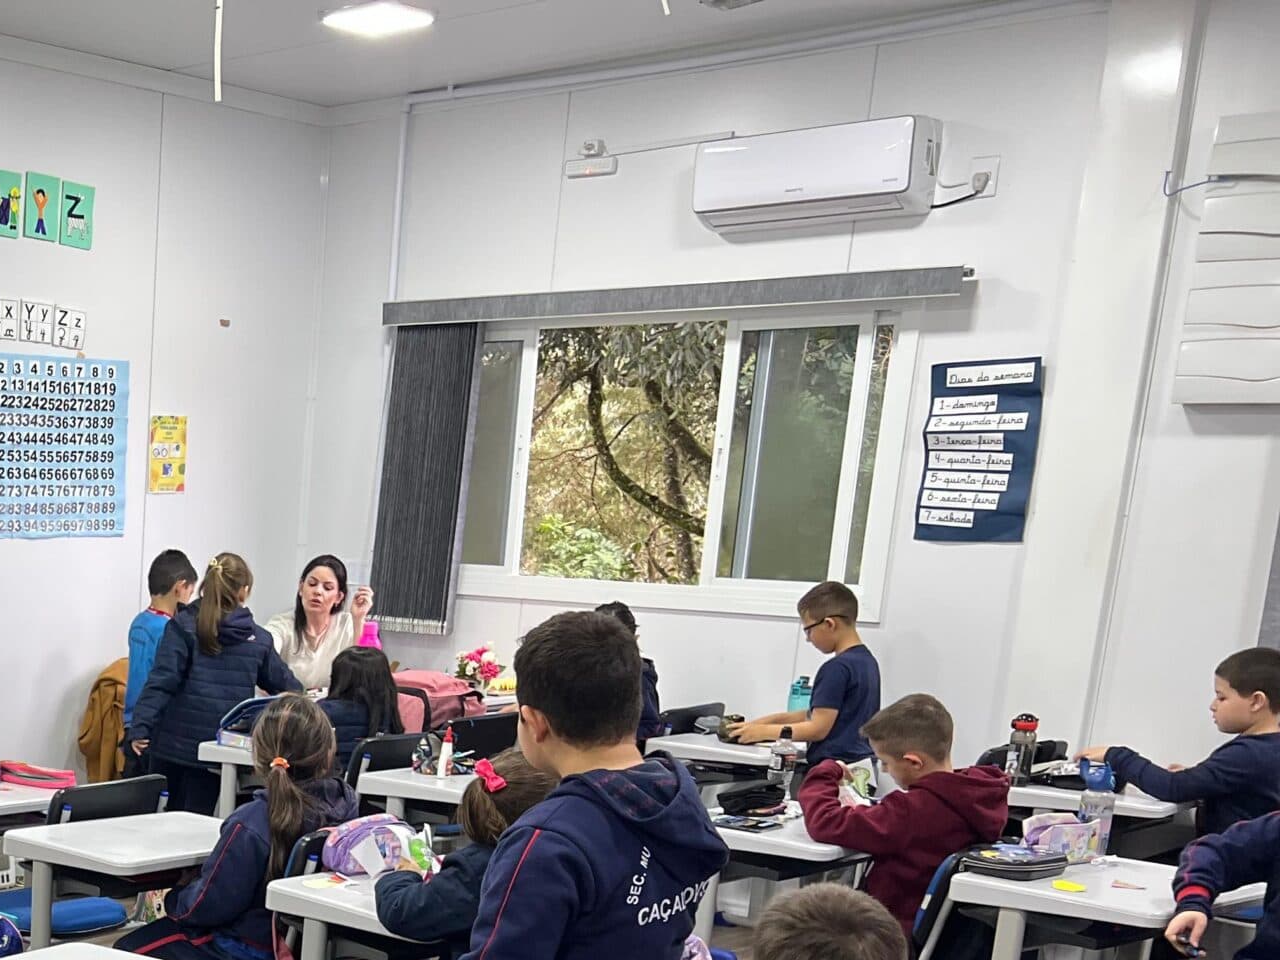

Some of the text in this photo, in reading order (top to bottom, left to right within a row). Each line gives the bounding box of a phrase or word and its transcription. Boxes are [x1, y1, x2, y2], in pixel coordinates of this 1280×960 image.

[15, 363, 21, 374] 3
[31, 363, 37, 374] 4
[47, 365, 53, 376] 5
[62, 366, 67, 376] 6
[76, 367, 82, 377] 7
[93, 367, 98, 377] 8
[108, 368, 113, 378] 9
[12, 379, 23, 390] 13
[27, 381, 39, 392] 14
[41, 380, 55, 393] 15
[56, 382, 70, 395] 16
[71, 382, 84, 395] 17
[86, 382, 101, 395] 18
[102, 383, 116, 395] 19
[8, 396, 22, 408] 23
[23, 396, 39, 409] 24
[40, 397, 55, 411] 25
[55, 399, 69, 411] 26
[70, 399, 84, 411] 27
[85, 399, 100, 411] 28
[101, 399, 115, 412] 29
[7, 413, 22, 426] 33
[23, 414, 38, 426] 34
[39, 415, 54, 428] 35
[55, 416, 68, 429] 36
[70, 416, 84, 428] 37
[85, 417, 99, 428] 38
[100, 417, 113, 428] 39
[8, 432, 22, 444] 43
[24, 433, 37, 444] 44
[40, 433, 53, 444] 45
[54, 433, 68, 444] 46
[70, 434, 84, 444] 47
[85, 434, 98, 445] 48
[100, 434, 114, 445] 49
[8, 450, 21, 462] 53
[24, 450, 37, 462] 54
[40, 451, 53, 462] 55
[56, 451, 69, 462] 56
[70, 451, 84, 462] 57
[85, 451, 99, 462] 58
[101, 451, 114, 462] 59
[7, 467, 21, 479] 63
[23, 468, 37, 480] 64
[40, 469, 53, 480] 65
[55, 469, 68, 480] 66
[70, 468, 84, 480] 67
[85, 468, 99, 480] 68
[101, 468, 114, 479] 69
[8, 485, 22, 497] 73
[24, 485, 38, 497] 74
[40, 485, 54, 496] 75
[56, 485, 70, 496] 76
[70, 485, 84, 496] 77
[86, 485, 99, 496] 78
[101, 485, 115, 496] 79
[627, 872, 647, 905] SEC.
